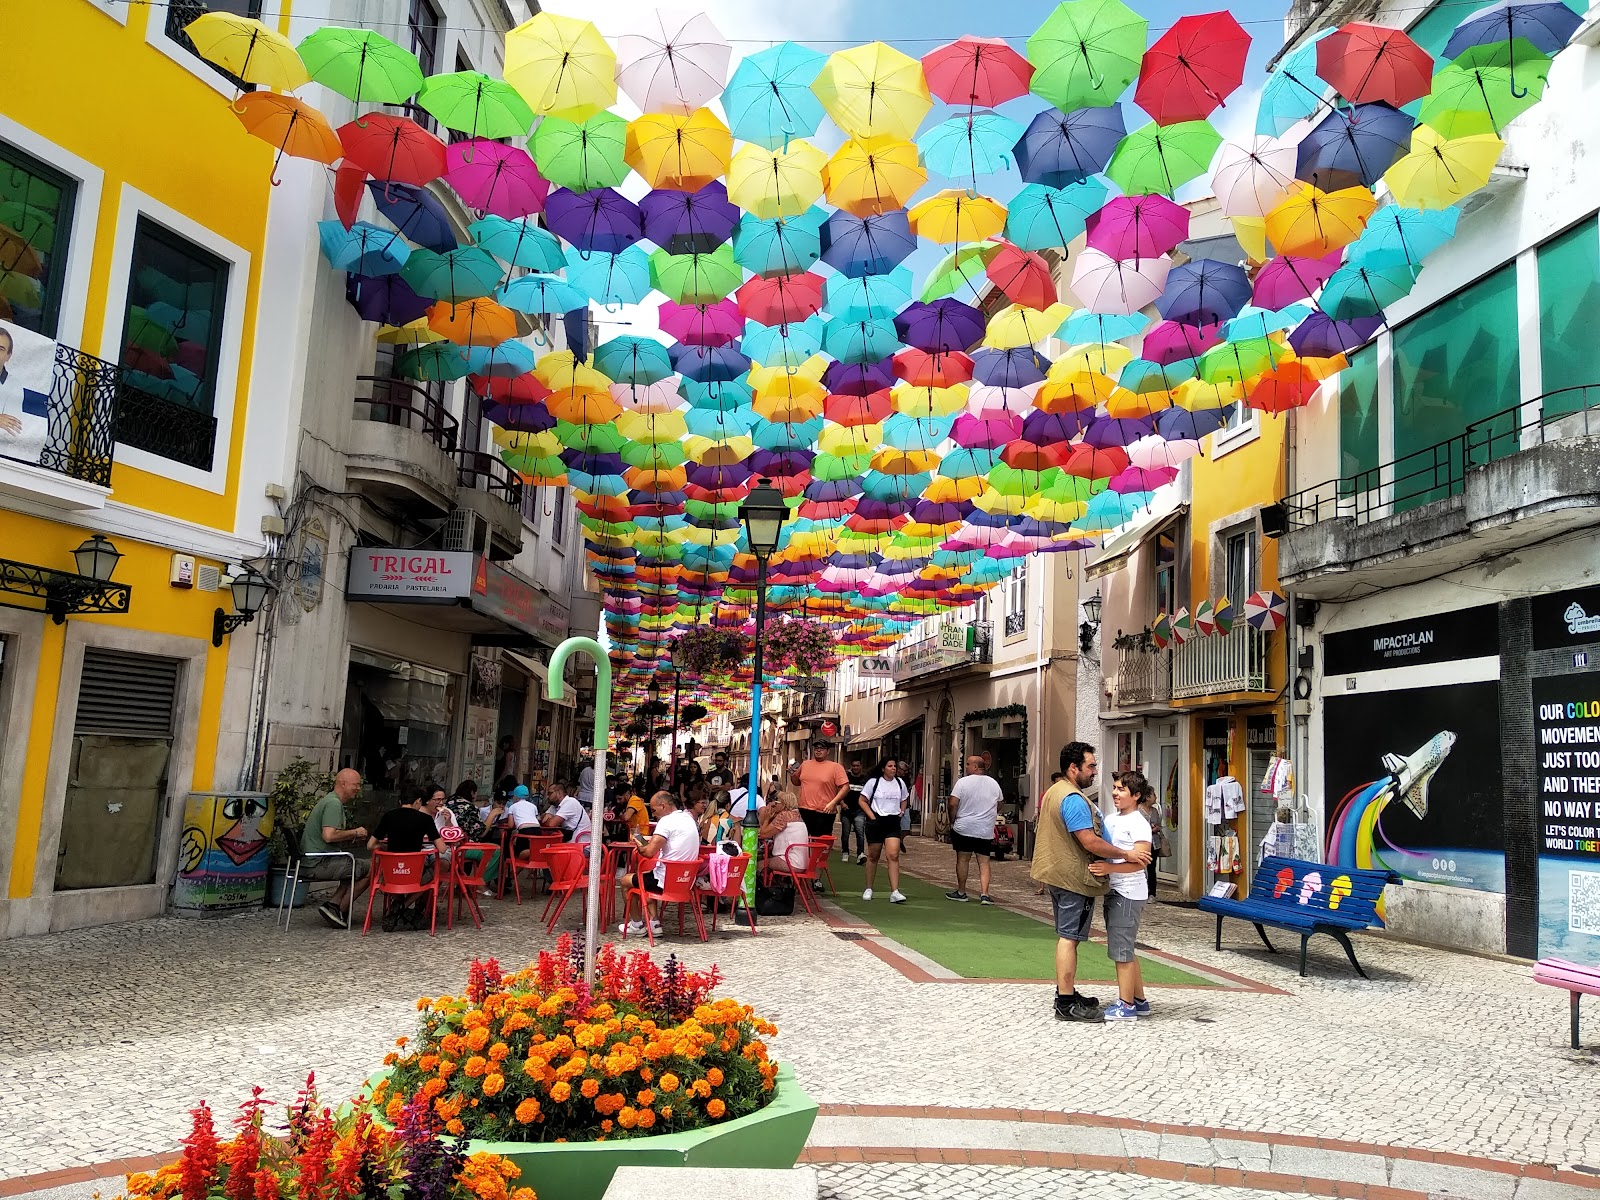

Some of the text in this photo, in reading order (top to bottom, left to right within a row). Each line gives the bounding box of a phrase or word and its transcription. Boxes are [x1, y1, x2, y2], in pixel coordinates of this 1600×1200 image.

[368, 555, 452, 575] TRIGAL
[369, 583, 447, 592] PADARIA PASTELARIA
[943, 625, 964, 634] TRAN
[942, 633, 964, 641] QUILI
[942, 640, 964, 648] DADE
[1384, 646, 1421, 658] ART PRODUCTIONS
[862, 659, 890, 670] OM
[1574, 653, 1587, 667] 111
[1540, 700, 1600, 720] OUR COLO
[1542, 751, 1572, 769] JUST
[1543, 776, 1569, 793] AND
[1544, 801, 1561, 817] NO
[1563, 802, 1591, 818] WAY
[1545, 824, 1567, 837] LET'S
[1568, 825, 1595, 838] COLOR
[1545, 838, 1600, 852] WORLD TOGET
[393, 867, 411, 875] SAGRES
